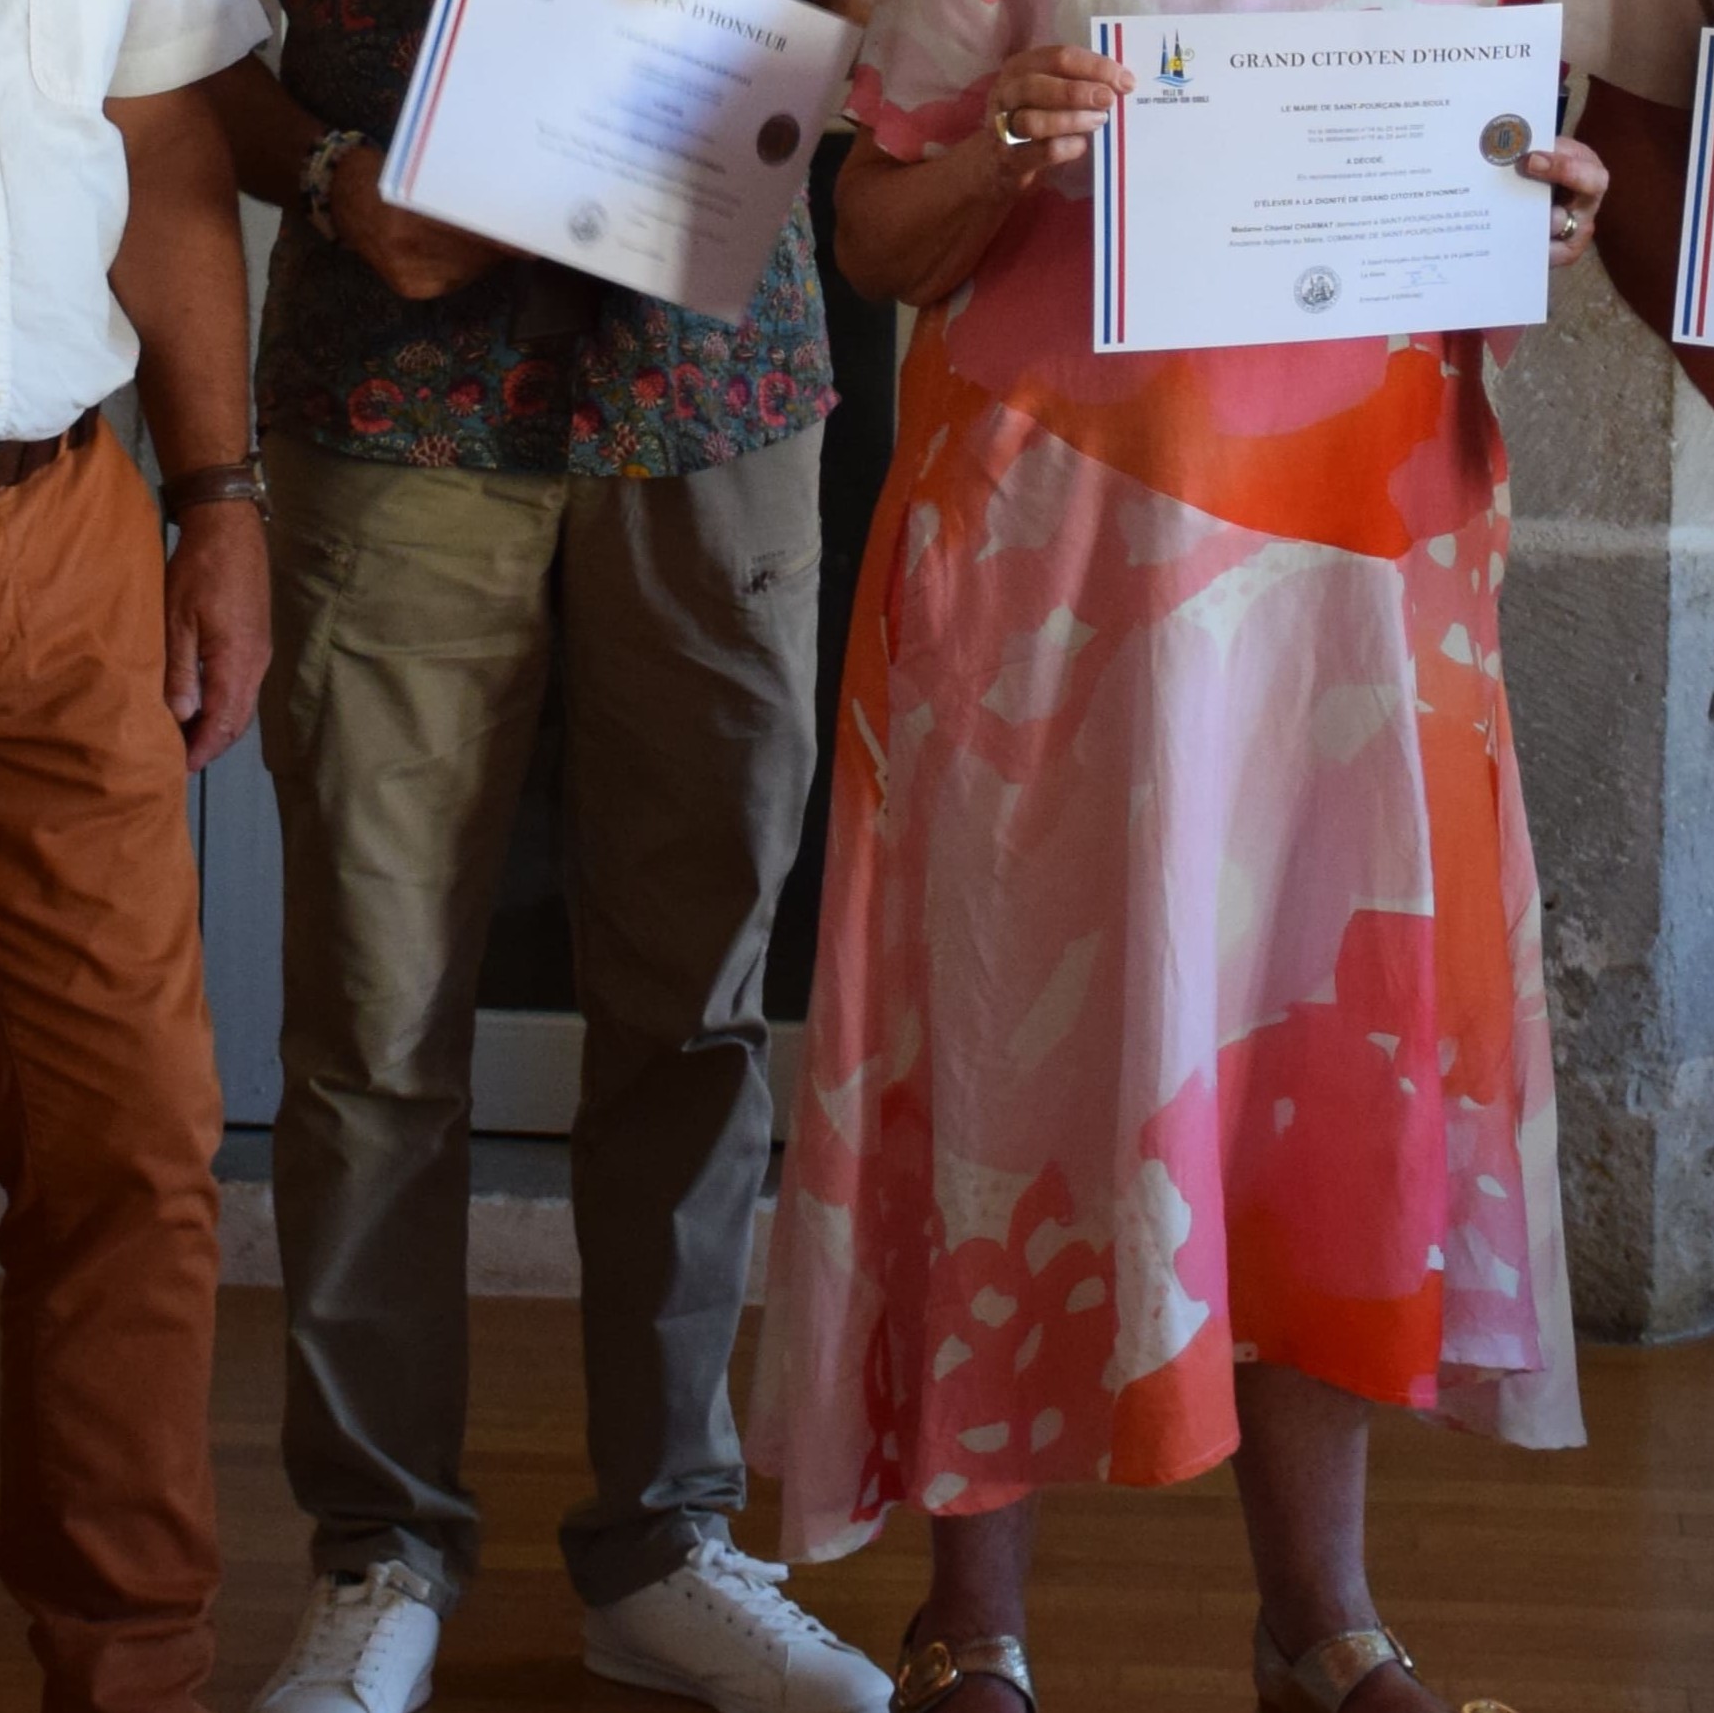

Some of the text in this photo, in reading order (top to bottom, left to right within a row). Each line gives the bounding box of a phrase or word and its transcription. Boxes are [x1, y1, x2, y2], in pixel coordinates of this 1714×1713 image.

[691, 3, 788, 53] D'HONNEUR
[1228, 43, 1532, 70] GRAND CITOYEN D'HONNEUR
[1280, 105, 1290, 113] LE
[1292, 104, 1317, 112] MAIRE
[1320, 103, 1330, 111] DE
[1302, 197, 1312, 205] LA
[1348, 194, 1358, 203] DE
[1360, 193, 1389, 202] GRAND
[1390, 190, 1424, 200] CITOYEN
